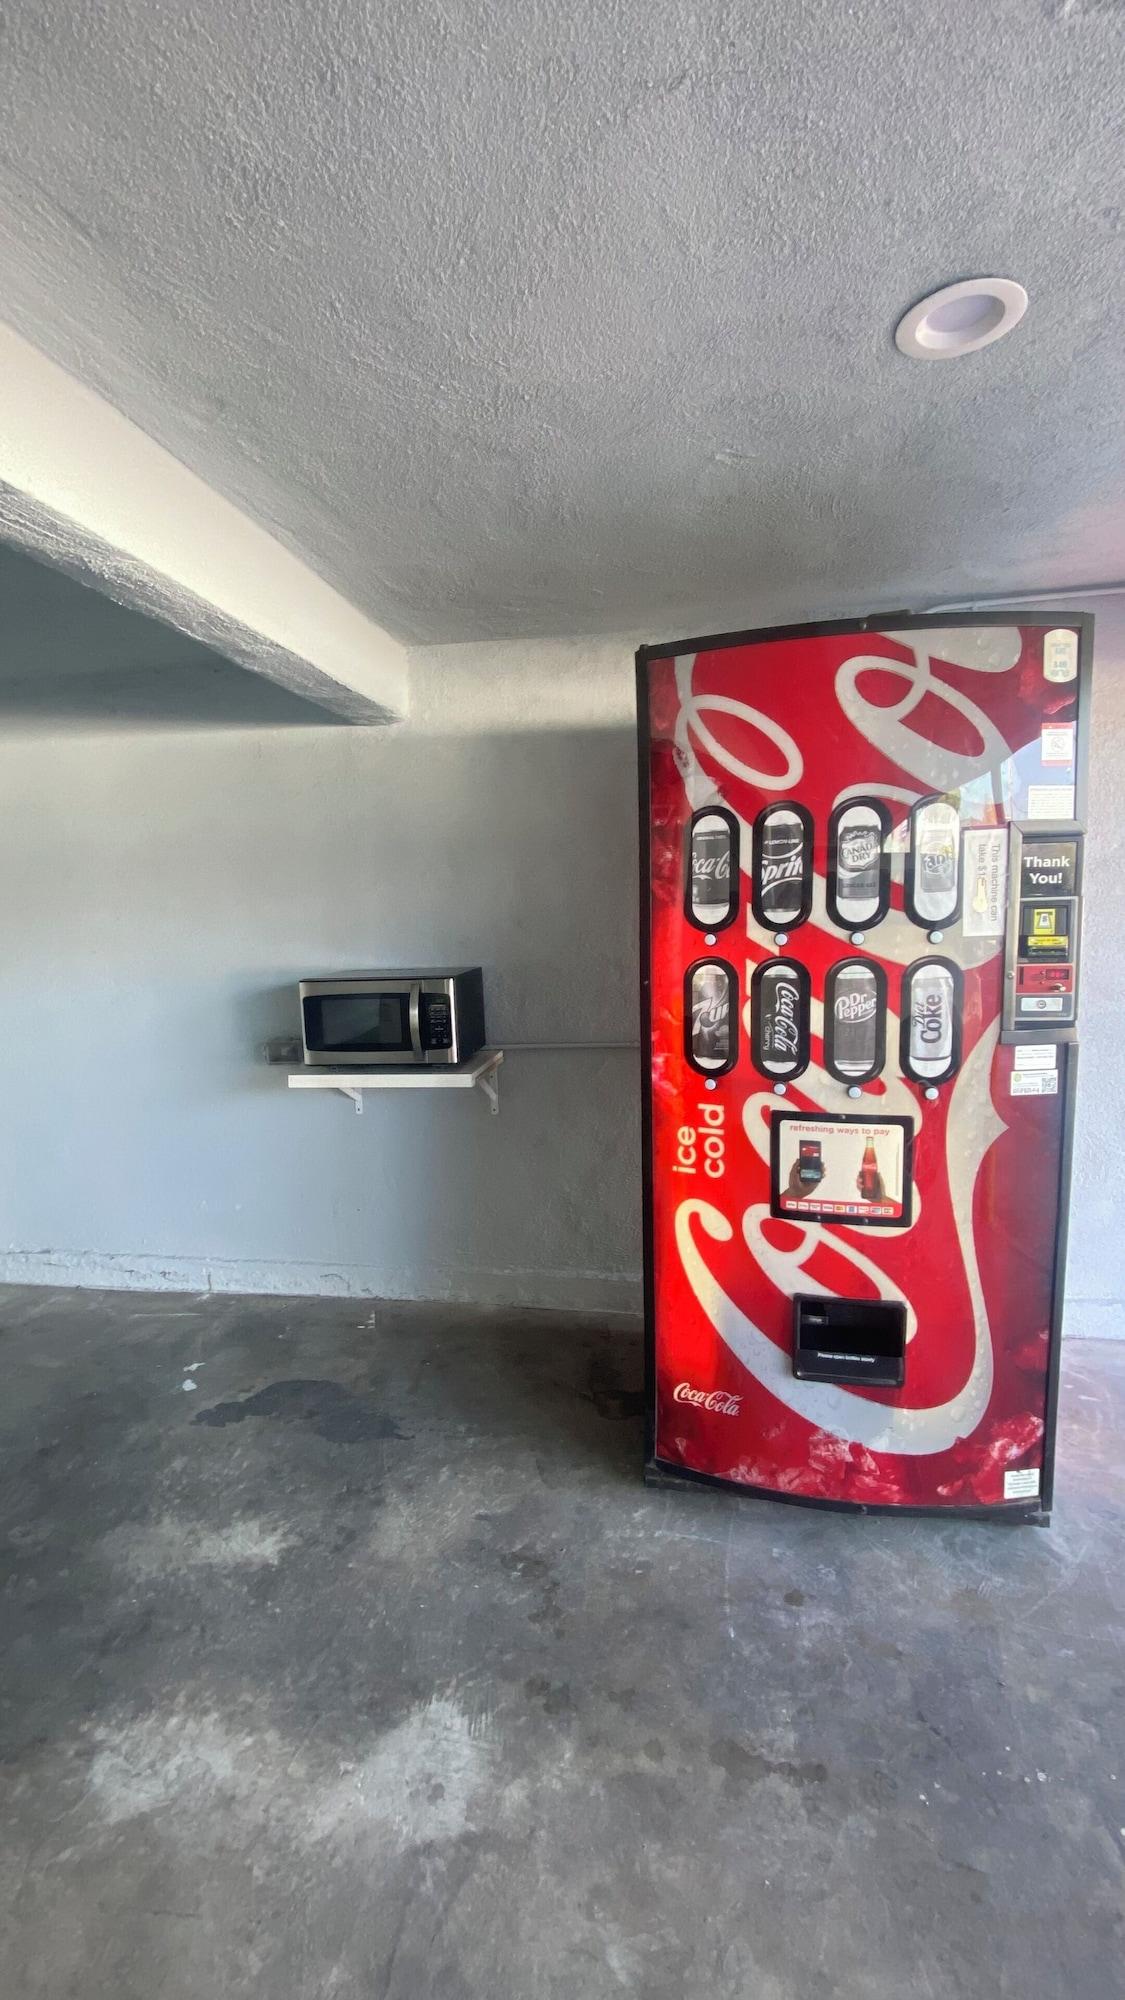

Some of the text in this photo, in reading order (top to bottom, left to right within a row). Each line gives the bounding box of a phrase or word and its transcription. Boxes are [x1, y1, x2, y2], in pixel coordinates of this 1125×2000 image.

[841, 842, 874, 859] CANAD
[852, 851, 871, 863] DRY
[978, 843, 987, 864] take
[991, 843, 1001, 863] This
[1023, 855, 1070, 868] Thank
[991, 864, 1001, 903] machine
[1029, 873, 1063, 884] You!
[838, 996, 877, 1020] Pepper
[849, 992, 868, 1005] Dr
[775, 982, 800, 1056] Coca-Cola
[912, 1001, 925, 1030] Diet
[920, 994, 942, 1044] Coke
[790, 1124, 834, 1135] refreshing
[836, 1126, 859, 1135] ways
[862, 1127, 871, 1135] to
[672, 1126, 697, 1175] ice
[697, 1103, 725, 1179] cold
[673, 1382, 744, 1417] Coca-Cola
